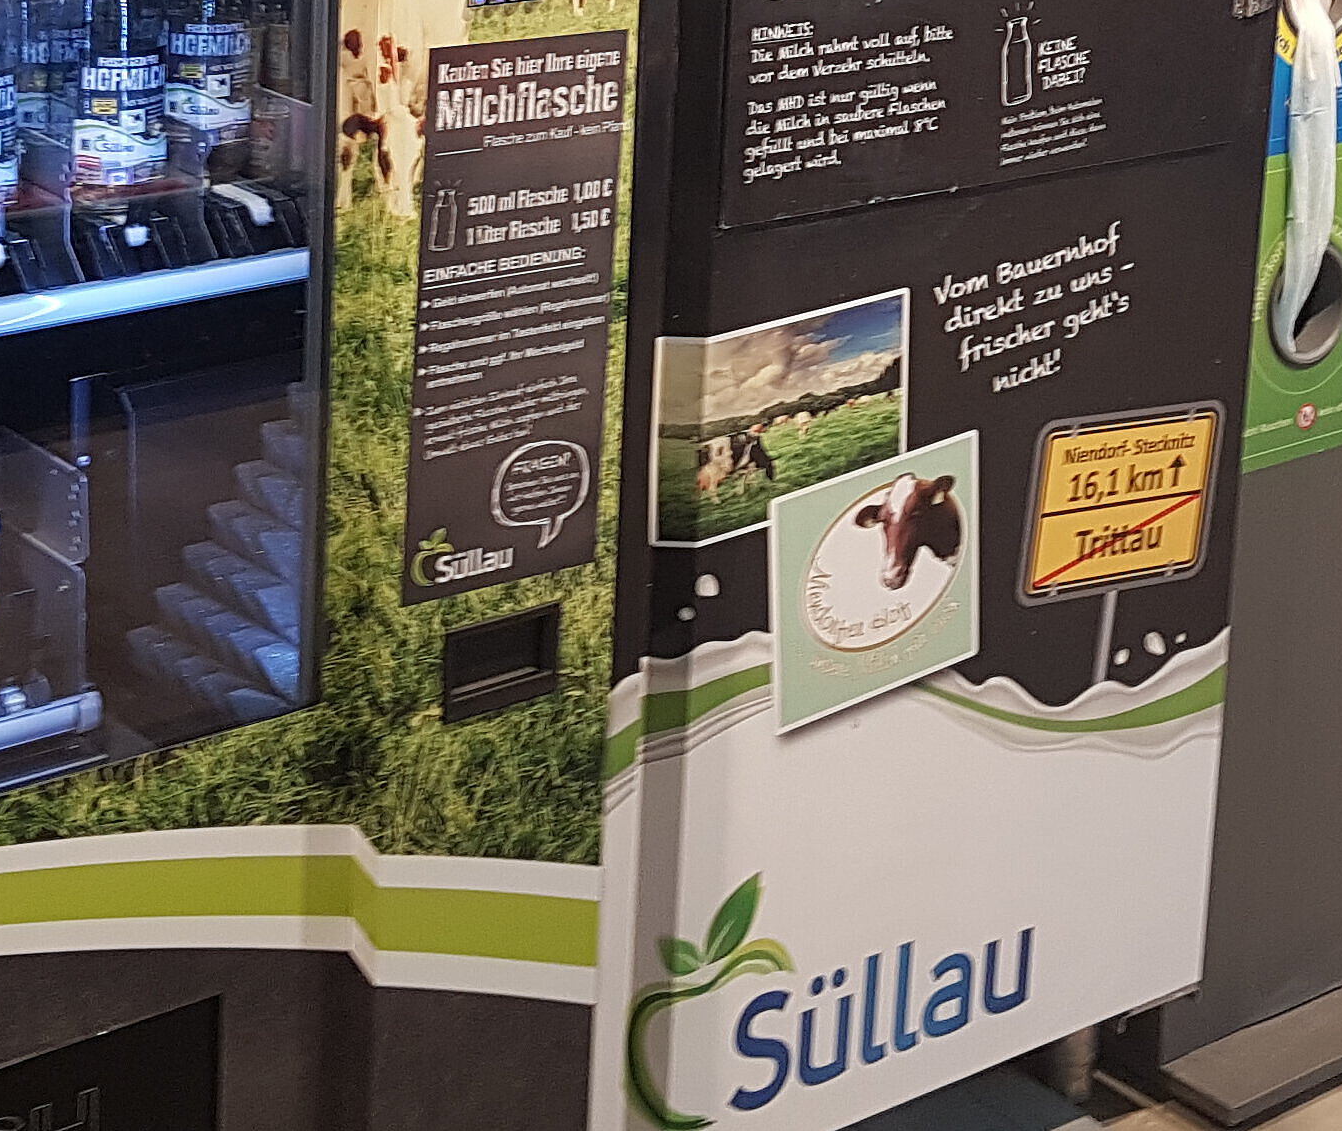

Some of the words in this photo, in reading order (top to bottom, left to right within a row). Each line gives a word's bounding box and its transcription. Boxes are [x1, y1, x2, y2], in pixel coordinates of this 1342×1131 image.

[751, 21, 814, 42] HINWEIS:
[751, 49, 773, 64] Die
[777, 42, 814, 60] Milch
[862, 32, 890, 49] voll
[923, 25, 953, 42] bitte
[1038, 35, 1078, 57] KEINE
[437, 61, 489, 85] Kaufen
[491, 58, 513, 79] Sie
[515, 55, 544, 75] hier
[545, 52, 574, 72] Ihre
[575, 49, 621, 73] eigene
[748, 72, 774, 84] vor
[777, 64, 809, 80] dem
[812, 57, 862, 77] Verzehr
[1037, 49, 1091, 74] FLASCHE
[435, 76, 619, 132] Milchflasche
[745, 120, 771, 136] die
[774, 114, 811, 134] Milch
[814, 113, 830, 126] in
[886, 97, 947, 117] Flaschen
[747, 101, 773, 116] Das
[776, 95, 804, 112] MHD
[807, 90, 827, 107] ist
[859, 83, 899, 106] gültig
[901, 80, 937, 94] wenn
[796, 131, 825, 150] und
[828, 128, 849, 145] bei
[467, 195, 496, 216] 500
[498, 192, 516, 211] ml
[517, 186, 569, 208] Flasche
[573, 181, 602, 204] 1,00
[603, 178, 614, 198] €
[466, 227, 474, 246] 1
[475, 224, 507, 244] Liter
[509, 218, 562, 240] Flasche
[571, 210, 599, 234] 1,50
[599, 208, 611, 226] €
[422, 258, 497, 284] EINFACHE
[498, 246, 586, 272] BEDIENUNG:
[933, 275, 990, 305] Vom
[995, 221, 1121, 285] Bauernhof
[944, 294, 1025, 333] direkt
[1032, 284, 1064, 305] zu
[1069, 268, 1113, 298] uns
[958, 320, 1056, 372] frischer
[993, 349, 1061, 393] nicht!
[1067, 468, 1120, 503] 16,1
[1125, 464, 1163, 493] km
[1074, 524, 1163, 560] Trittau
[434, 547, 514, 584] Süllau
[729, 926, 1036, 1112] Süllau
